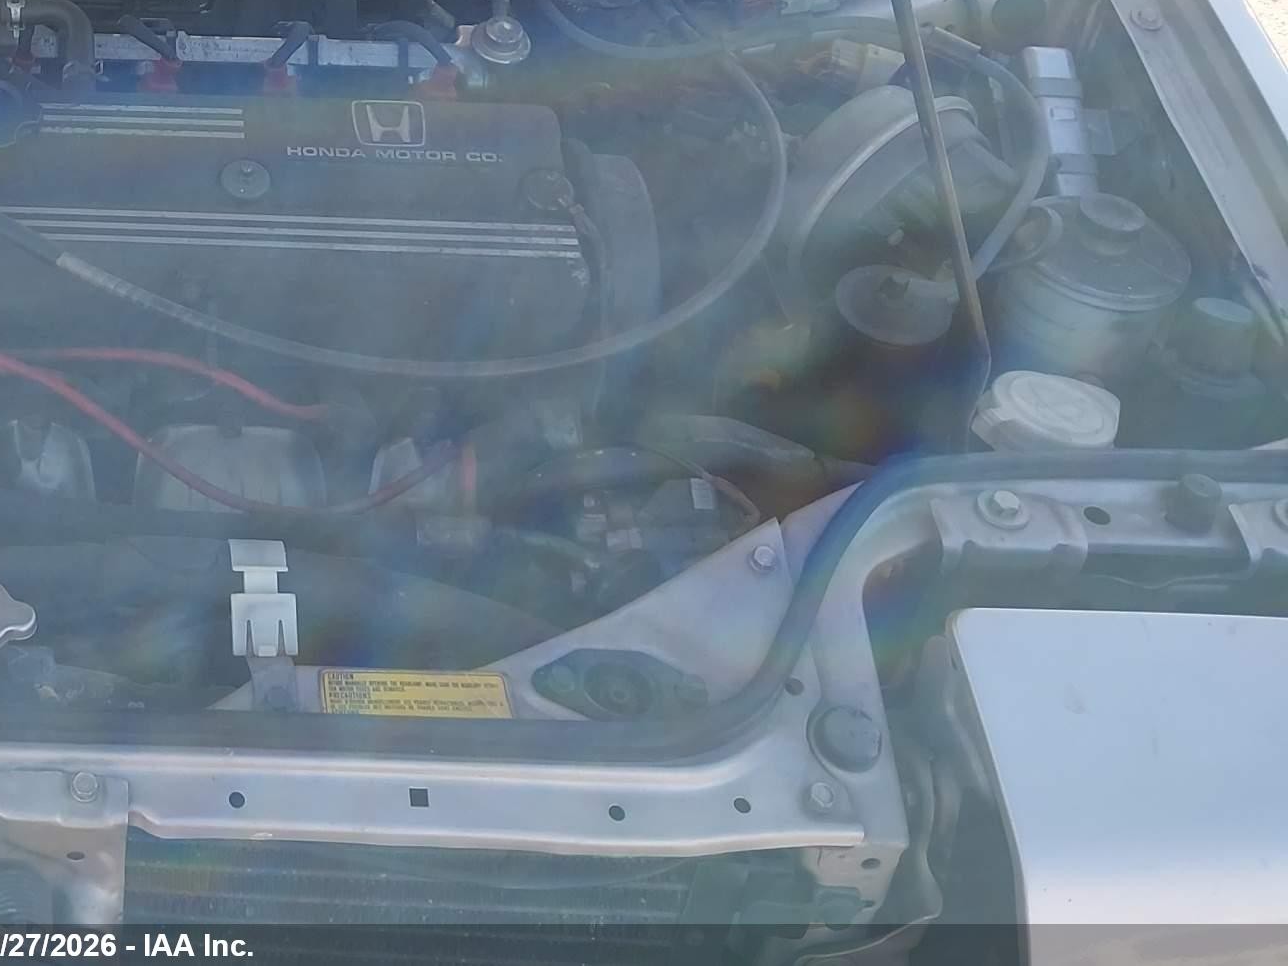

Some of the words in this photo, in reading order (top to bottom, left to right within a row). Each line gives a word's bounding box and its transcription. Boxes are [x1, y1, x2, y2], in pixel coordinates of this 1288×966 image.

[286, 145, 366, 158] HONDA
[375, 149, 457, 162] MOTOR
[465, 152, 504, 163] CO.
